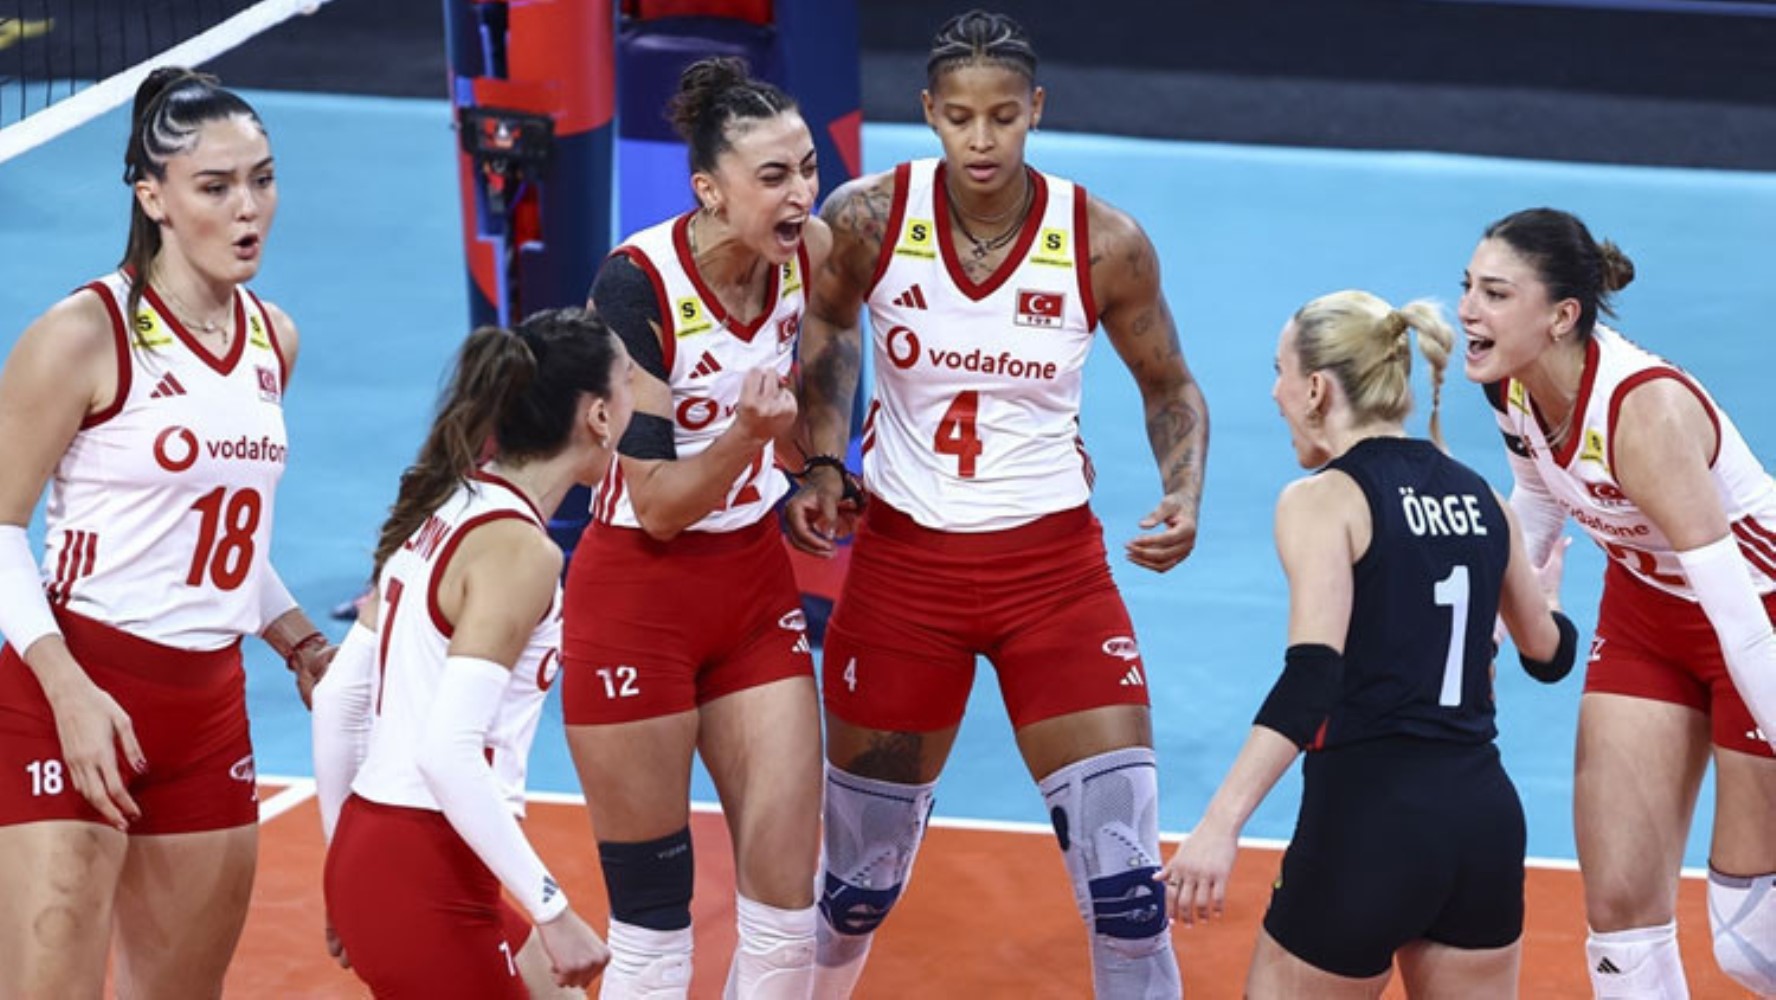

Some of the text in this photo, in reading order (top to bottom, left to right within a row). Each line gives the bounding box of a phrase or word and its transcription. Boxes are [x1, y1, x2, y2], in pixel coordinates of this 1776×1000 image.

[911, 224, 927, 242] S
[1045, 233, 1062, 250] S
[681, 301, 696, 319] S
[927, 348, 1057, 380] vodafone
[933, 389, 983, 479] 4
[1398, 486, 1488, 536] ÖRGE
[186, 485, 262, 593] 18
[1433, 564, 1471, 707] 1
[595, 664, 640, 699] 12
[843, 656, 858, 693] 4
[25, 759, 64, 797] 18
